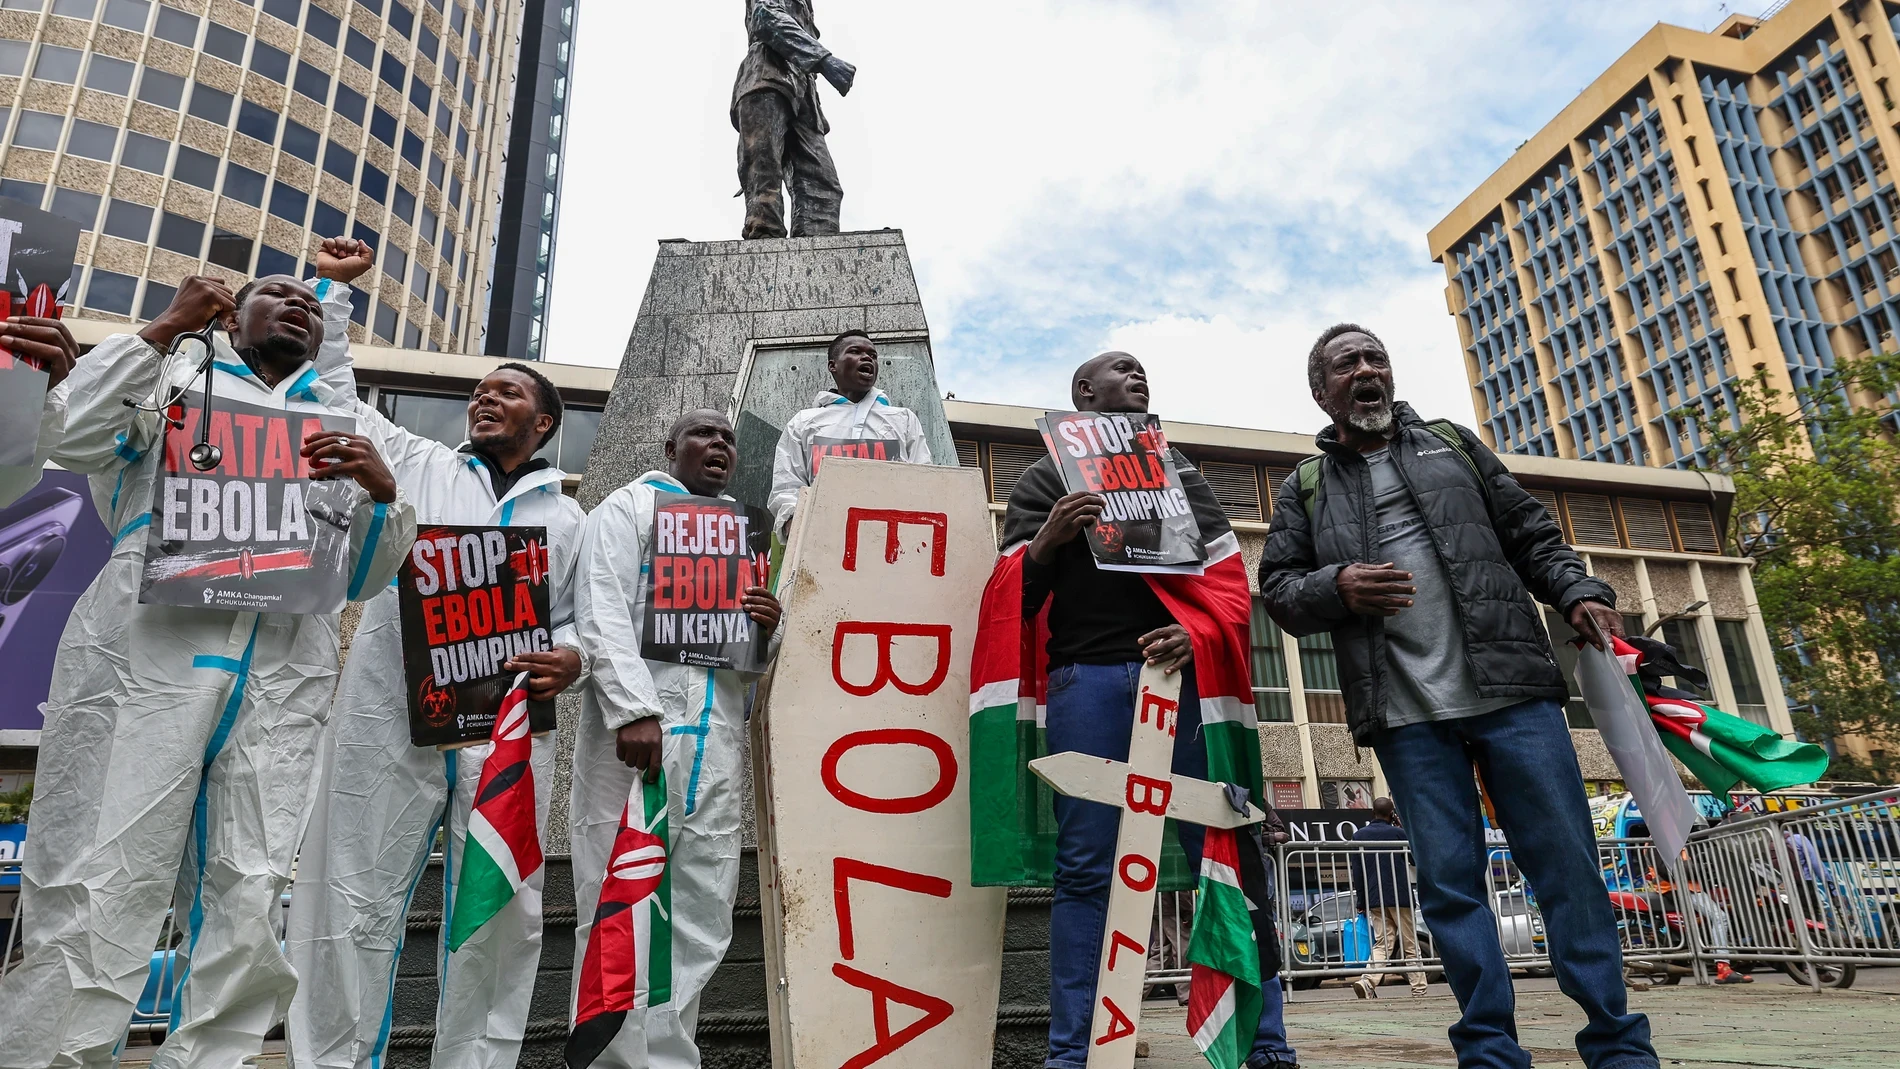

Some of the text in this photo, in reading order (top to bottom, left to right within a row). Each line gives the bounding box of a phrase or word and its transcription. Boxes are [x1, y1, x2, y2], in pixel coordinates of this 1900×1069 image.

[1058, 415, 1134, 458] STOP
[1423, 447, 1453, 455] Columbia
[1076, 454, 1171, 491] EBOLA
[162, 476, 310, 542] EBOLA
[1098, 488, 1192, 523] DUMPING
[657, 511, 749, 556] REJECT
[412, 530, 507, 596] STOP
[654, 556, 754, 610] EBOLA
[216, 599, 268, 608] #CHUKUAHATUA
[217, 590, 283, 602] AMKA Changamka!
[422, 582, 538, 645] EBOLA
[654, 613, 750, 644] IN KENYA
[430, 627, 549, 688] DUMPING
[688, 652, 704, 660] AMKA
[466, 713, 484, 721] AMKA
[821, 506, 957, 1069] EBOLA
[1095, 688, 1178, 1046] EBOLA
